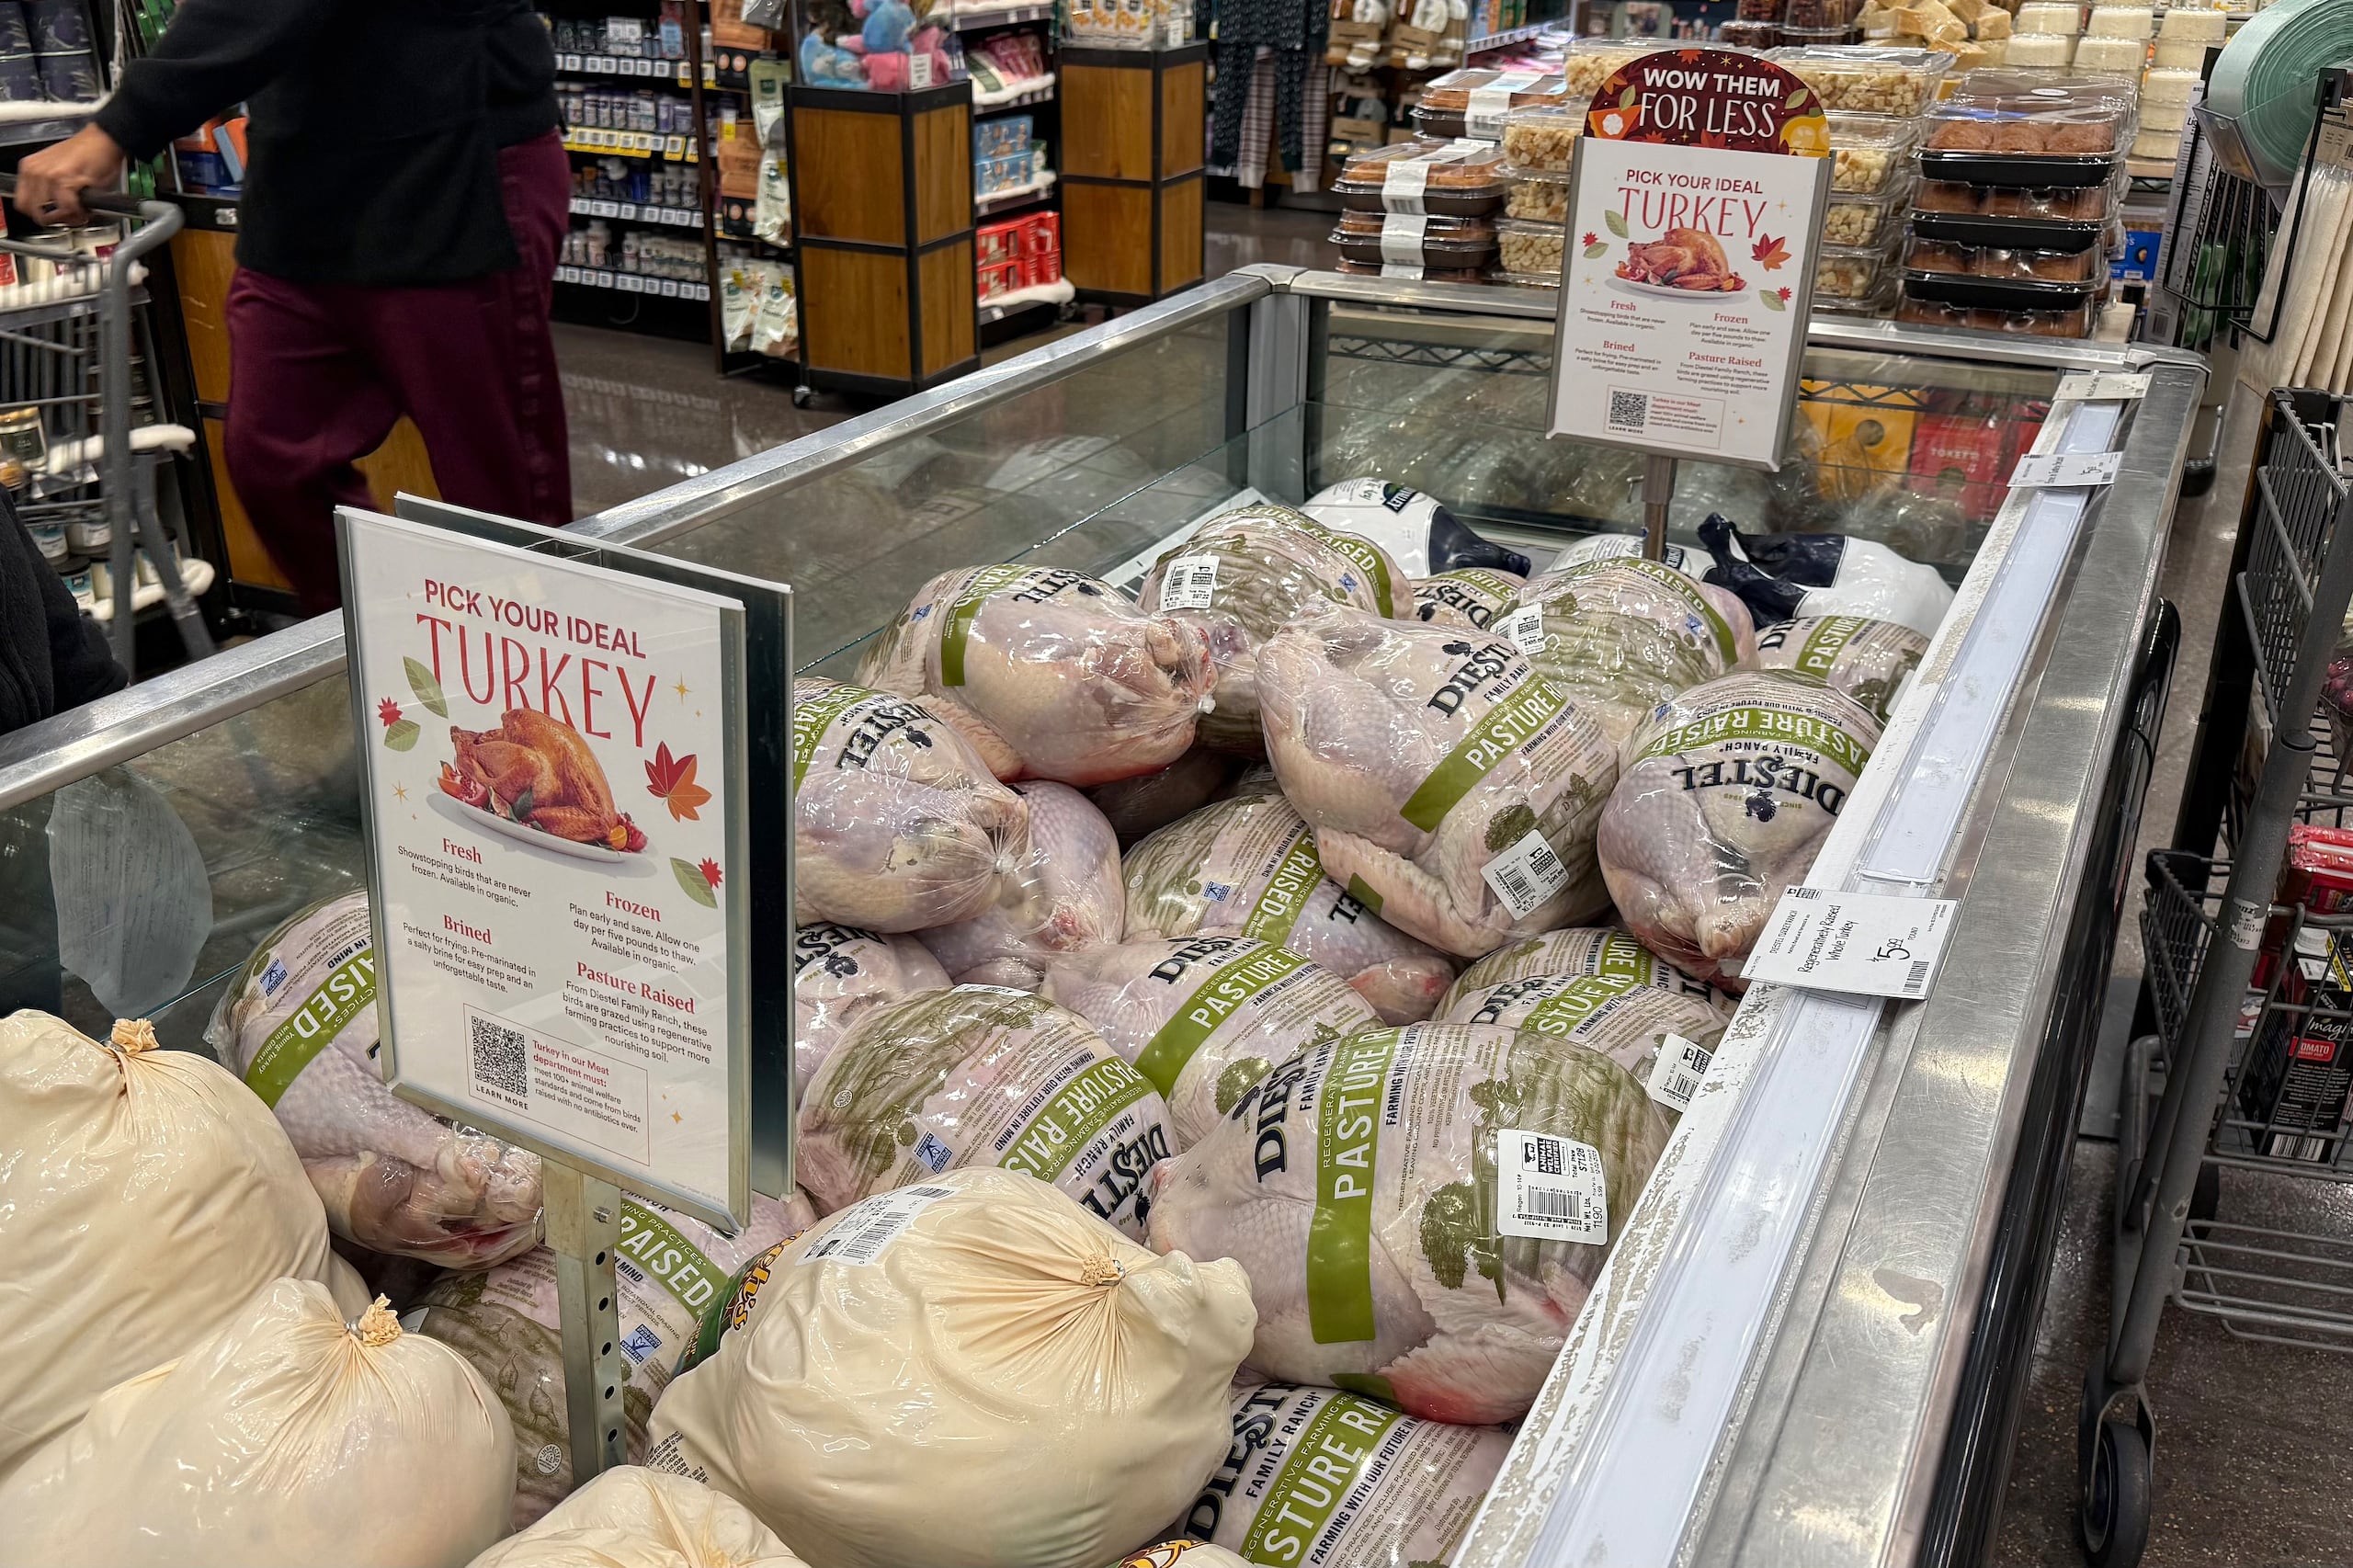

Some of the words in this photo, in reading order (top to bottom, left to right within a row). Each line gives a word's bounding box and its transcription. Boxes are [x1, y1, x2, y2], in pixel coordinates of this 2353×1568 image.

[1643, 67, 1707, 91] WOW
[1640, 92, 1698, 131] FOR
[1706, 97, 1777, 138] LESS
[1626, 169, 1663, 185] PICK
[1668, 174, 1711, 190] YOUR
[1715, 178, 1763, 195] IDEAL
[1618, 187, 1768, 239] TURKEY
[1610, 301, 1637, 312] Fresh
[1714, 312, 1749, 324] Frozen
[1603, 340, 1635, 353] Brined
[1688, 352, 1726, 365] Pasture
[1728, 356, 1762, 368] Raised
[424, 578, 483, 617] PICK
[488, 596, 559, 638] YOUR
[566, 616, 647, 659] IDEAL
[416, 613, 657, 748] TURKEY
[1427, 642, 1518, 719] DIEST
[1483, 677, 1513, 702] FAMILY
[1464, 689, 1556, 771] PASTURE
[1651, 710, 1750, 752] RAISED
[1773, 747, 1820, 765] FAMILY
[1671, 755, 1846, 817] DIESTEL
[398, 846, 453, 873] Showstopping
[455, 864, 474, 879] birds
[476, 872, 492, 885] that
[494, 880, 506, 890] are
[508, 884, 531, 898] never
[442, 838, 483, 864] Fresh
[412, 863, 438, 880] frozen.
[440, 873, 475, 892] Available
[477, 886, 484, 895] in
[486, 891, 518, 907] organic.
[1261, 850, 1316, 916] RAISED
[570, 903, 587, 917] Plan
[589, 912, 610, 926] early
[613, 918, 630, 930] and
[631, 924, 654, 937] save.
[655, 931, 681, 946] Allow
[683, 942, 699, 952] one
[606, 891, 661, 922] Frozen
[1820, 904, 1842, 930] Raised
[403, 922, 431, 939] Perfect
[432, 933, 443, 944] for
[445, 937, 470, 954] frying.
[472, 947, 527, 974] Pre-marinated
[529, 968, 536, 977] in
[443, 915, 492, 945] Brined
[574, 919, 589, 933] day
[591, 926, 605, 938] per
[608, 929, 623, 942] five
[626, 937, 658, 954] pounds
[660, 947, 669, 957] to
[672, 949, 696, 965] thaw.
[1824, 938, 1845, 960] Whole
[1835, 920, 1859, 939] Turkey
[414, 939, 432, 954] salty
[434, 944, 453, 960] brine
[455, 954, 465, 965] for
[467, 960, 485, 972] easy
[486, 967, 505, 980] prep
[506, 972, 521, 984] and
[523, 979, 533, 989] an
[433, 958, 484, 984] unforgettable
[486, 978, 508, 993] taste.
[591, 937, 631, 958] Available
[632, 950, 641, 961] in
[643, 956, 678, 973] organic.
[566, 981, 587, 995] From
[590, 989, 620, 1006] Diestel
[621, 1000, 650, 1017] Family
[652, 1009, 681, 1028] Ranch,
[684, 1021, 708, 1036] these
[577, 961, 636, 994] Pasture
[641, 983, 695, 1014] Raised
[1188, 953, 1293, 1029] PASTURE
[563, 993, 584, 1007] birds
[585, 1002, 598, 1011] are
[601, 1007, 630, 1022] grazed
[632, 1018, 655, 1033] using
[657, 1027, 712, 1051] regenerative
[564, 1006, 597, 1027] farming
[599, 1020, 638, 1040] practices
[641, 1034, 650, 1044] to
[652, 1039, 686, 1056] support
[688, 1051, 710, 1064] more
[532, 1040, 560, 1059] Turkey
[562, 1051, 570, 1061] in
[572, 1056, 585, 1067] our
[587, 1061, 609, 1075] Meat
[605, 1035, 650, 1058] nourishing
[652, 1051, 669, 1063] soil.
[2301, 1042, 2330, 1054] OMATO
[533, 1053, 582, 1078] department
[584, 1073, 607, 1087] must:
[534, 1067, 551, 1079] meet
[571, 1080, 594, 1095] animal
[596, 1089, 621, 1104] welfare
[1044, 1078, 1058, 1096] OUR
[1299, 1069, 1322, 1111] FAMILY
[1385, 1077, 1404, 1127] FARMING
[1397, 1052, 1408, 1076] WITH
[476, 1084, 502, 1100] LEARN
[505, 1096, 529, 1110] MORE
[535, 1078, 568, 1096] standards
[569, 1090, 583, 1101] and
[584, 1096, 604, 1108] come
[604, 1104, 621, 1115] from
[623, 1109, 642, 1123] birds
[535, 1088, 556, 1101] raised
[558, 1096, 573, 1108] with
[574, 1103, 583, 1111] no
[584, 1107, 620, 1126] antibiotics
[621, 1122, 638, 1133] ever.
[1021, 1092, 1045, 1122] FUTURE
[1055, 1059, 1144, 1127] PASTURE
[995, 1129, 1012, 1152] MIND
[1010, 1118, 1022, 1132] IN
[1108, 1113, 1135, 1142] FAMILY
[1254, 1054, 1307, 1184] DIEST
[1323, 1071, 1341, 1168] REGENERATIVE
[1335, 1046, 1390, 1199] PASTURE
[1078, 1123, 1172, 1221] DIESTE
[1539, 1140, 1547, 1172] ANIMAL
[1552, 1141, 1561, 1173] CERTIFIED
[617, 1261, 643, 1283] MIND
[1301, 1404, 1340, 1455] FARMING
[1183, 1382, 1298, 1542] DIEST
[1245, 1437, 1288, 1498] FAMILY
[1263, 1433, 1365, 1562] STURE
[1310, 1510, 1351, 1565] FARMING
[1347, 1483, 1372, 1514] WITH
[1365, 1459, 1388, 1483] OUR
[1379, 1426, 1410, 1460] FUTURE
[1346, 1513, 1375, 1552] PRACTICES
